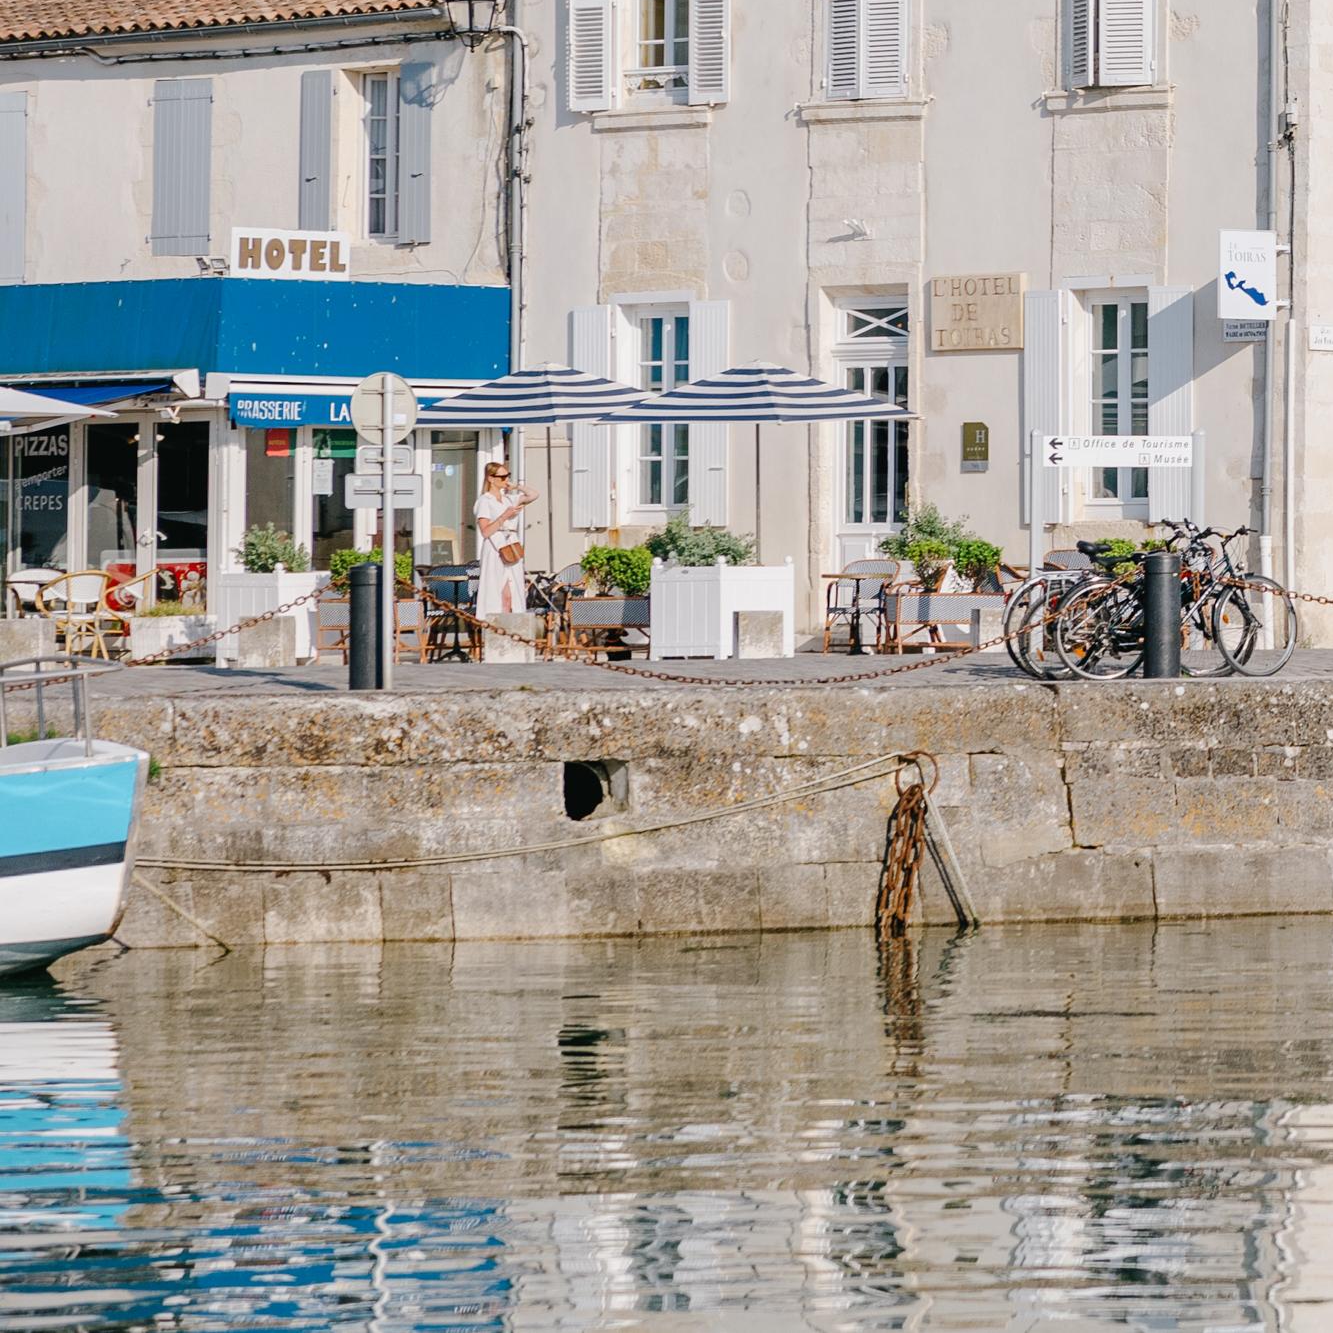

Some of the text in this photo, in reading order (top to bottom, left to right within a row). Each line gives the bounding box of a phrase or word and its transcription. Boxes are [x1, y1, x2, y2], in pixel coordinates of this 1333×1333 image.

[238, 237, 346, 272] HOTEL
[1228, 250, 1266, 263] TOIRAS
[933, 277, 1019, 297] L'HOTEL
[952, 303, 977, 321] DE
[935, 327, 1011, 346] TOIRAS
[237, 400, 302, 421] BRASSERIE
[976, 430, 985, 443] H
[1083, 439, 1190, 448] Office de Tourisme
[15, 435, 68, 457] PIZZAS
[1153, 453, 1190, 463] Musée
